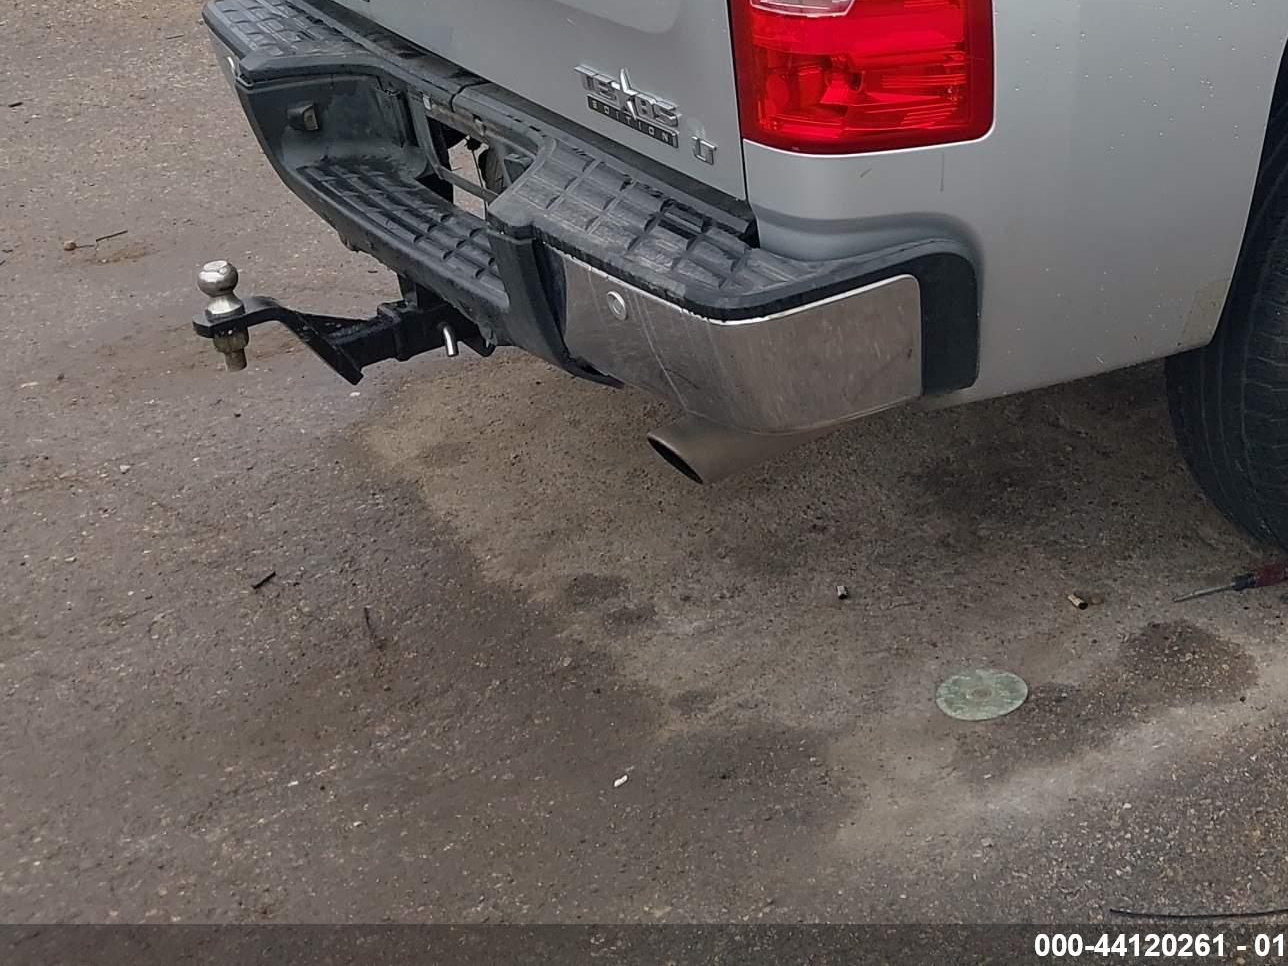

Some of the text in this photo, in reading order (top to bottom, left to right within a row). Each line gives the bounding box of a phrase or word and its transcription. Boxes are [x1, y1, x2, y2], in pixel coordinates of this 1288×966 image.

[573, 65, 682, 128] TEXAS
[590, 100, 670, 143] EDITION
[691, 135, 718, 166] LT
